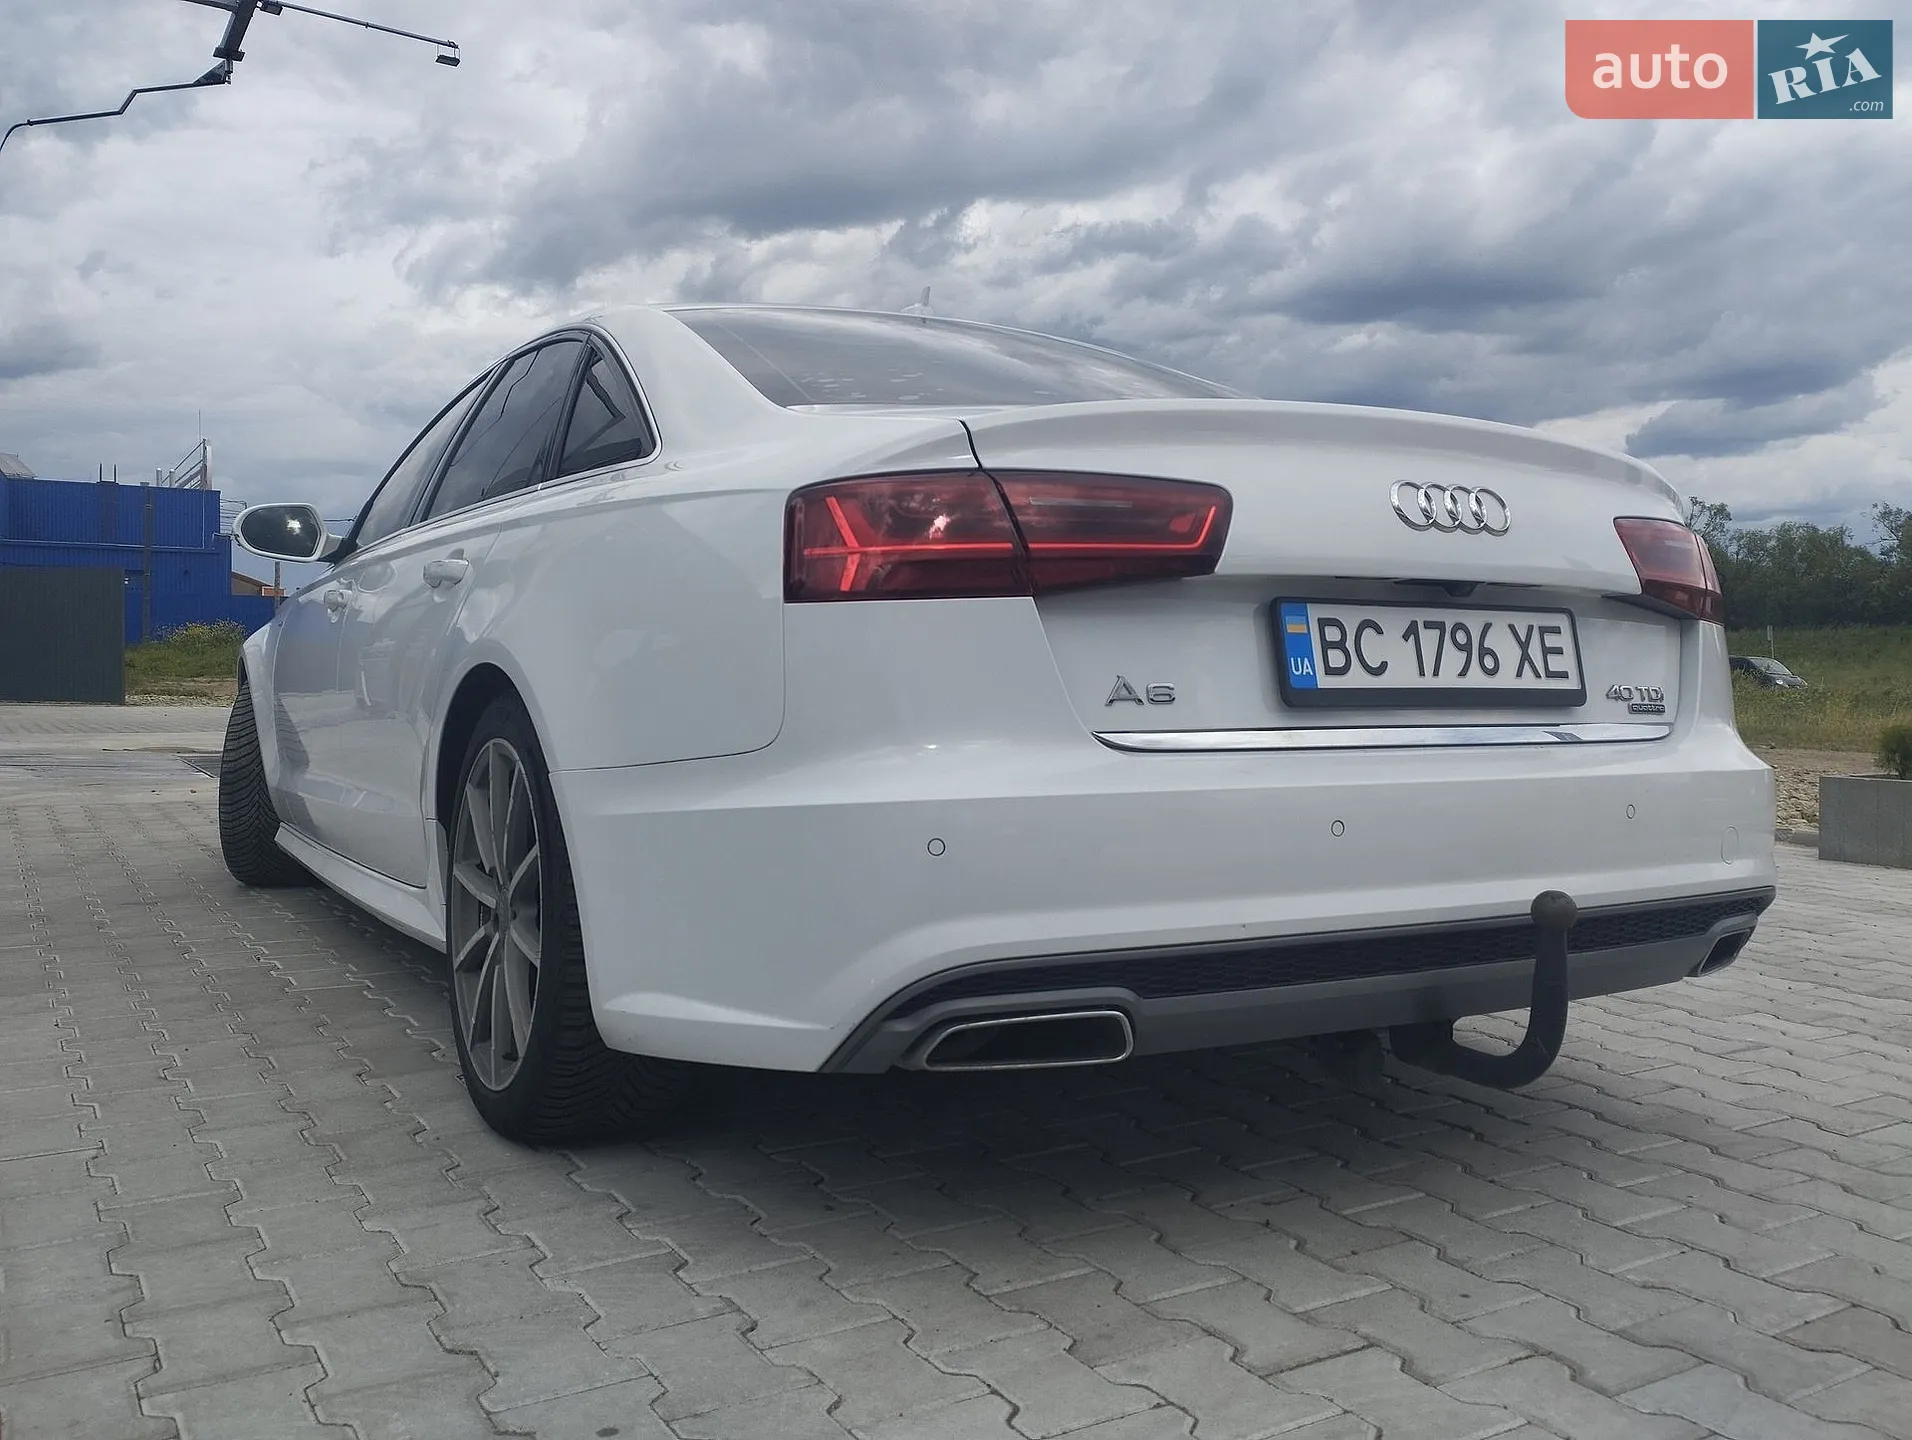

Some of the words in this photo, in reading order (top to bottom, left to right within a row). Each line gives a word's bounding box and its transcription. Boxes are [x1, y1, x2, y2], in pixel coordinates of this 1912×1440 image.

[1317, 617, 1389, 677] BC
[1402, 620, 1500, 678] 1796
[1508, 623, 1570, 680] XE
[1290, 656, 1314, 676] UA
[1105, 675, 1176, 707] A6
[1605, 684, 1634, 702] 40
